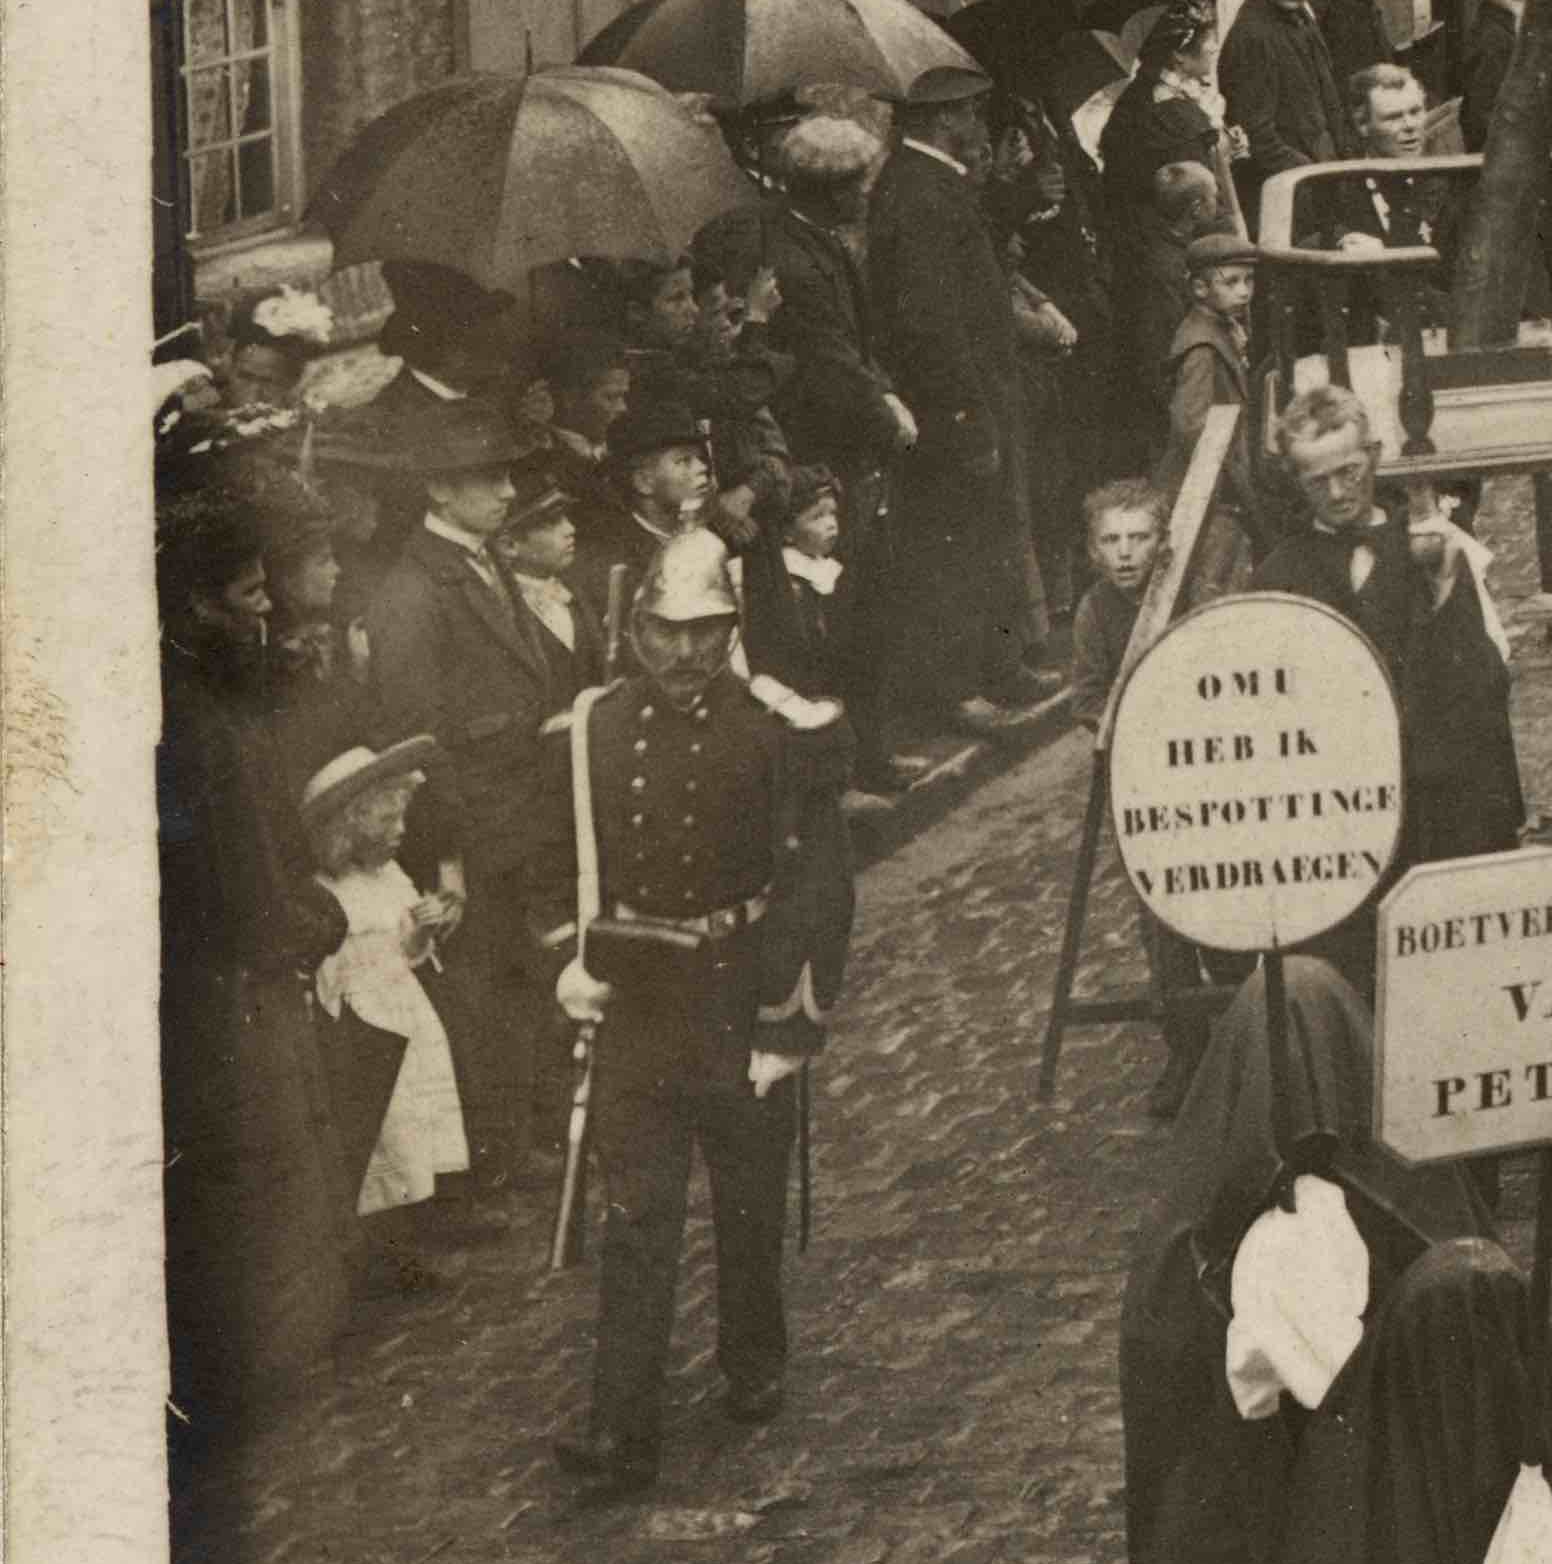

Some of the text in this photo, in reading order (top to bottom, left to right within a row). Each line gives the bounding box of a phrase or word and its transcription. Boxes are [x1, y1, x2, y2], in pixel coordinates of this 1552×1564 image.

[1197, 667, 1297, 701] OM U
[1167, 729, 1319, 769] HEB IK
[1123, 784, 1396, 838] BESPOTTINGE
[1135, 848, 1382, 896] VERDRAEGEN
